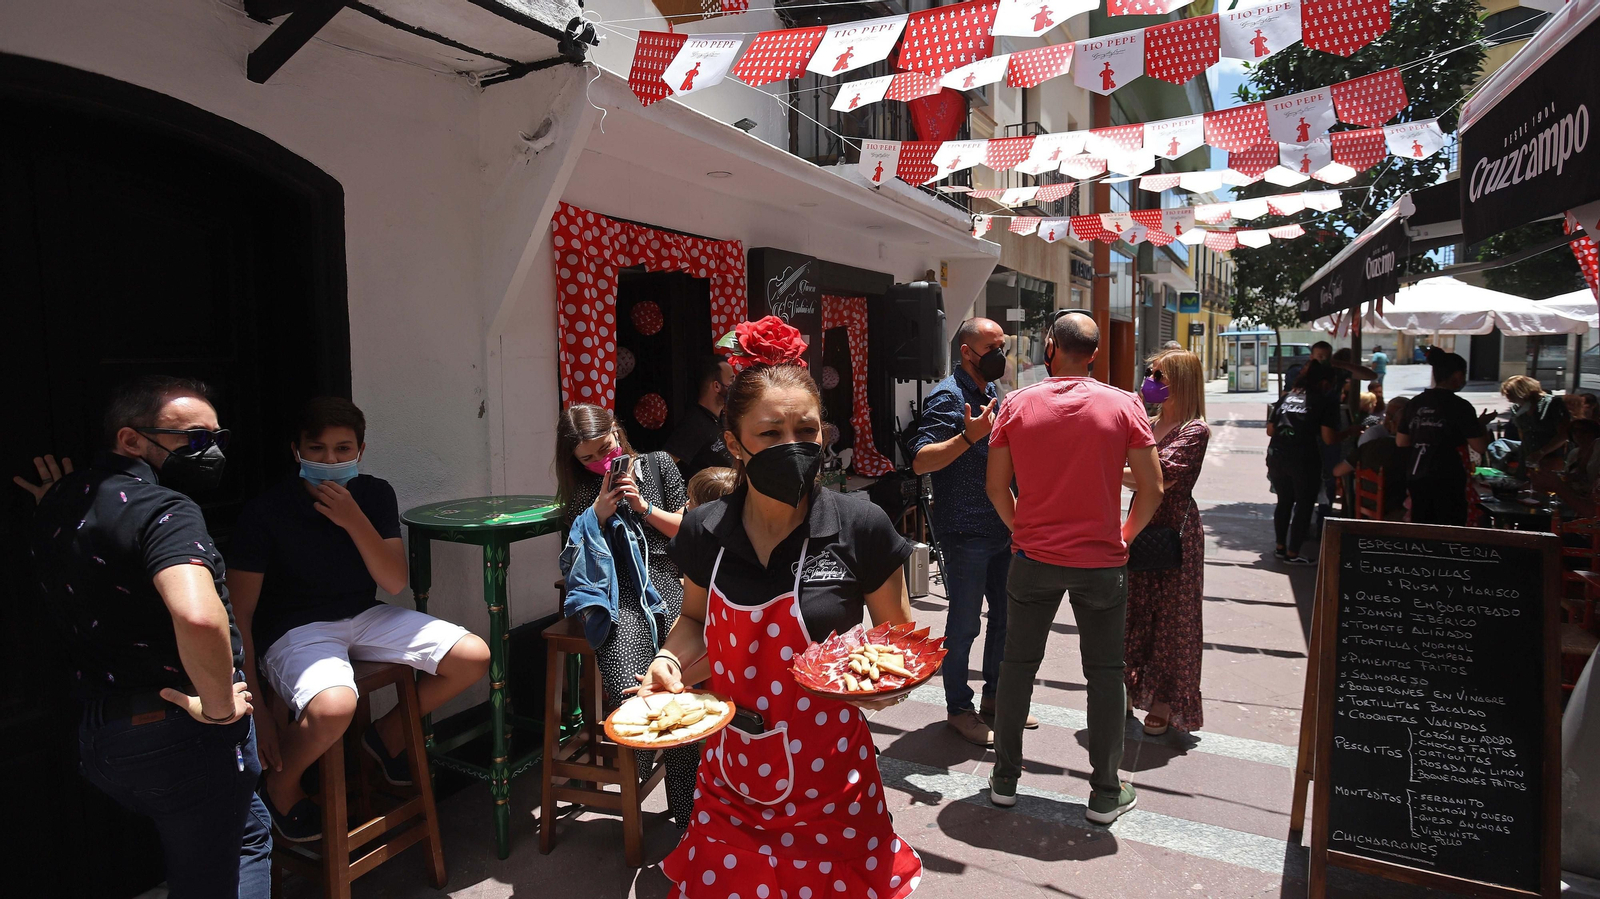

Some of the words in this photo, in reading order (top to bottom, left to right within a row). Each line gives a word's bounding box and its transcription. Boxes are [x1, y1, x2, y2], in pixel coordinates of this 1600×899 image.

[1229, 11, 1252, 21] TIO
[1257, 2, 1292, 16] PEPE
[833, 28, 857, 38] TIO
[861, 23, 896, 34] PEPE
[690, 40, 708, 48] TIO
[710, 40, 736, 48] PEPE
[1083, 42, 1103, 52] TIO
[1107, 36, 1136, 48] PEPE
[1273, 101, 1293, 111] TIO
[1297, 94, 1324, 105] PEPE
[1151, 123, 1170, 131] TIO
[1171, 118, 1197, 128] PEPE
[1390, 126, 1407, 134] TIO
[1409, 123, 1432, 132] PEPE
[1504, 122, 1528, 148] DESDE
[1469, 104, 1590, 202] Cruzcampo
[1358, 538, 1433, 553] ESPECIAL
[1442, 543, 1502, 559] FERIA
[1360, 560, 1472, 580] ENSALADILLAS
[1400, 578, 1438, 592] RUSA
[1462, 586, 1520, 599] MARISCO
[1355, 591, 1401, 604] QUESO
[1414, 598, 1520, 618] EMBORRIZADO
[1355, 606, 1402, 618] JAMÓN
[1410, 613, 1477, 627] IBÉRICO
[1349, 620, 1404, 634] TOMATE
[1412, 628, 1472, 640] ALIÑADO
[1348, 635, 1411, 650] TORTILLA
[1422, 641, 1474, 652] NORMAL
[1348, 652, 1411, 670] PIMIENTOS
[1414, 660, 1468, 676] FRITOS
[1422, 650, 1474, 662] CAMPERA
[1351, 669, 1428, 686] SALMOREJO
[1347, 681, 1424, 698] BOQUERONES
[1434, 691, 1452, 700] EN
[1456, 690, 1506, 706] VINAGRE
[1346, 694, 1420, 710] TORTILLITAS
[1426, 702, 1486, 718] BACALAO
[1348, 709, 1418, 724] CROQUETAS
[1425, 716, 1488, 732] VARIADAS
[1334, 736, 1403, 758] PESCAITOS
[1418, 739, 1464, 753] CHOCOS
[1469, 744, 1517, 758] FRITOS
[1460, 734, 1476, 744] EN
[1480, 736, 1513, 746] ADOBO
[1418, 750, 1492, 766] ORTIGUITAS
[1418, 758, 1466, 774] ROSADA
[1490, 764, 1524, 778] LIMÓN
[1417, 769, 1486, 786] BOQUERONES
[1490, 778, 1527, 792] FRITOS
[1335, 786, 1402, 804] MONTADITOS
[1420, 794, 1485, 808] SERRANITO
[1419, 814, 1452, 825] QUESO
[1459, 820, 1510, 834] ANCHOAS
[1480, 812, 1514, 822] QUESO
[1420, 825, 1480, 841] VIOLINISTA
[1332, 830, 1438, 858] CHICHARRONES
